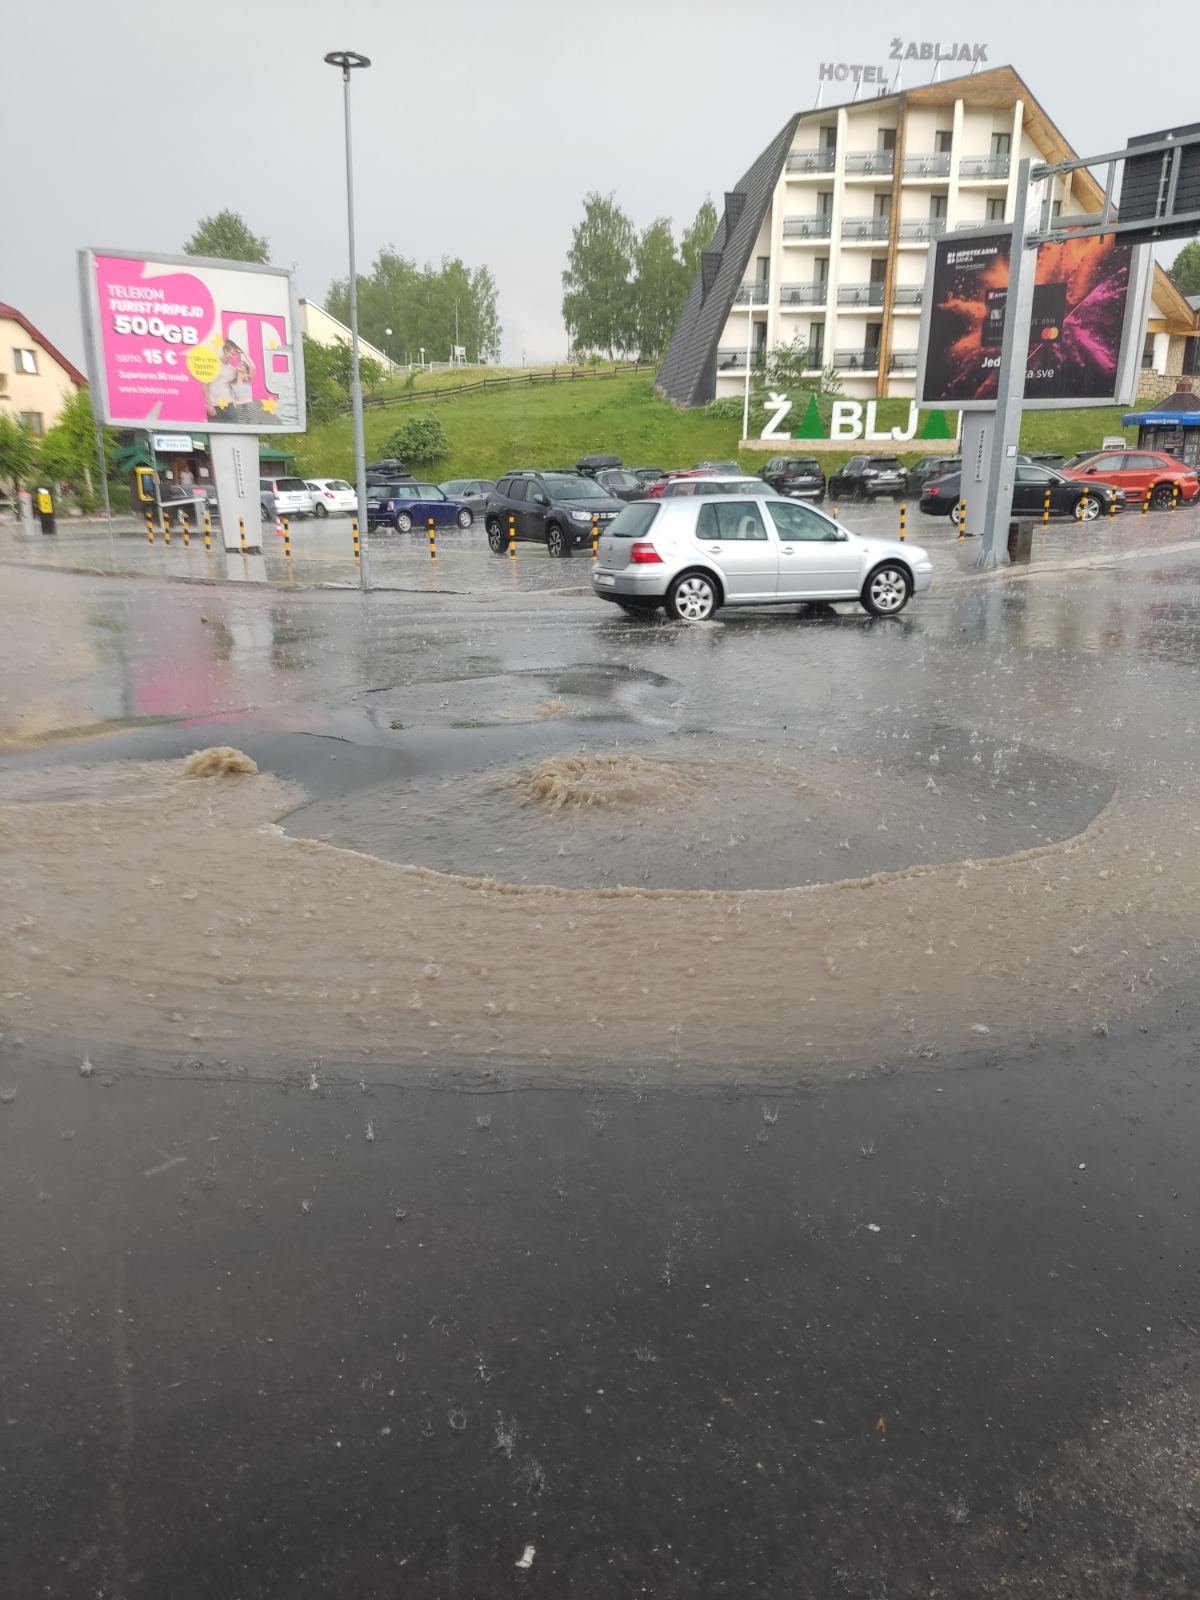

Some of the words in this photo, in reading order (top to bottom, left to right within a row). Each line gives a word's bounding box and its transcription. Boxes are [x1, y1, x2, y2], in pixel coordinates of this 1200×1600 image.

[888, 37, 989, 62] ŽABLJAK
[818, 62, 889, 84] HOTEL
[108, 284, 165, 301] TELEKOM
[109, 298, 154, 315] TURIST
[154, 303, 204, 318] PRIPEJD
[113, 314, 199, 345] 500GB
[142, 348, 163, 365] 15
[164, 349, 177, 365] €
[981, 356, 1002, 369] Jed
[1036, 368, 1055, 378] sve
